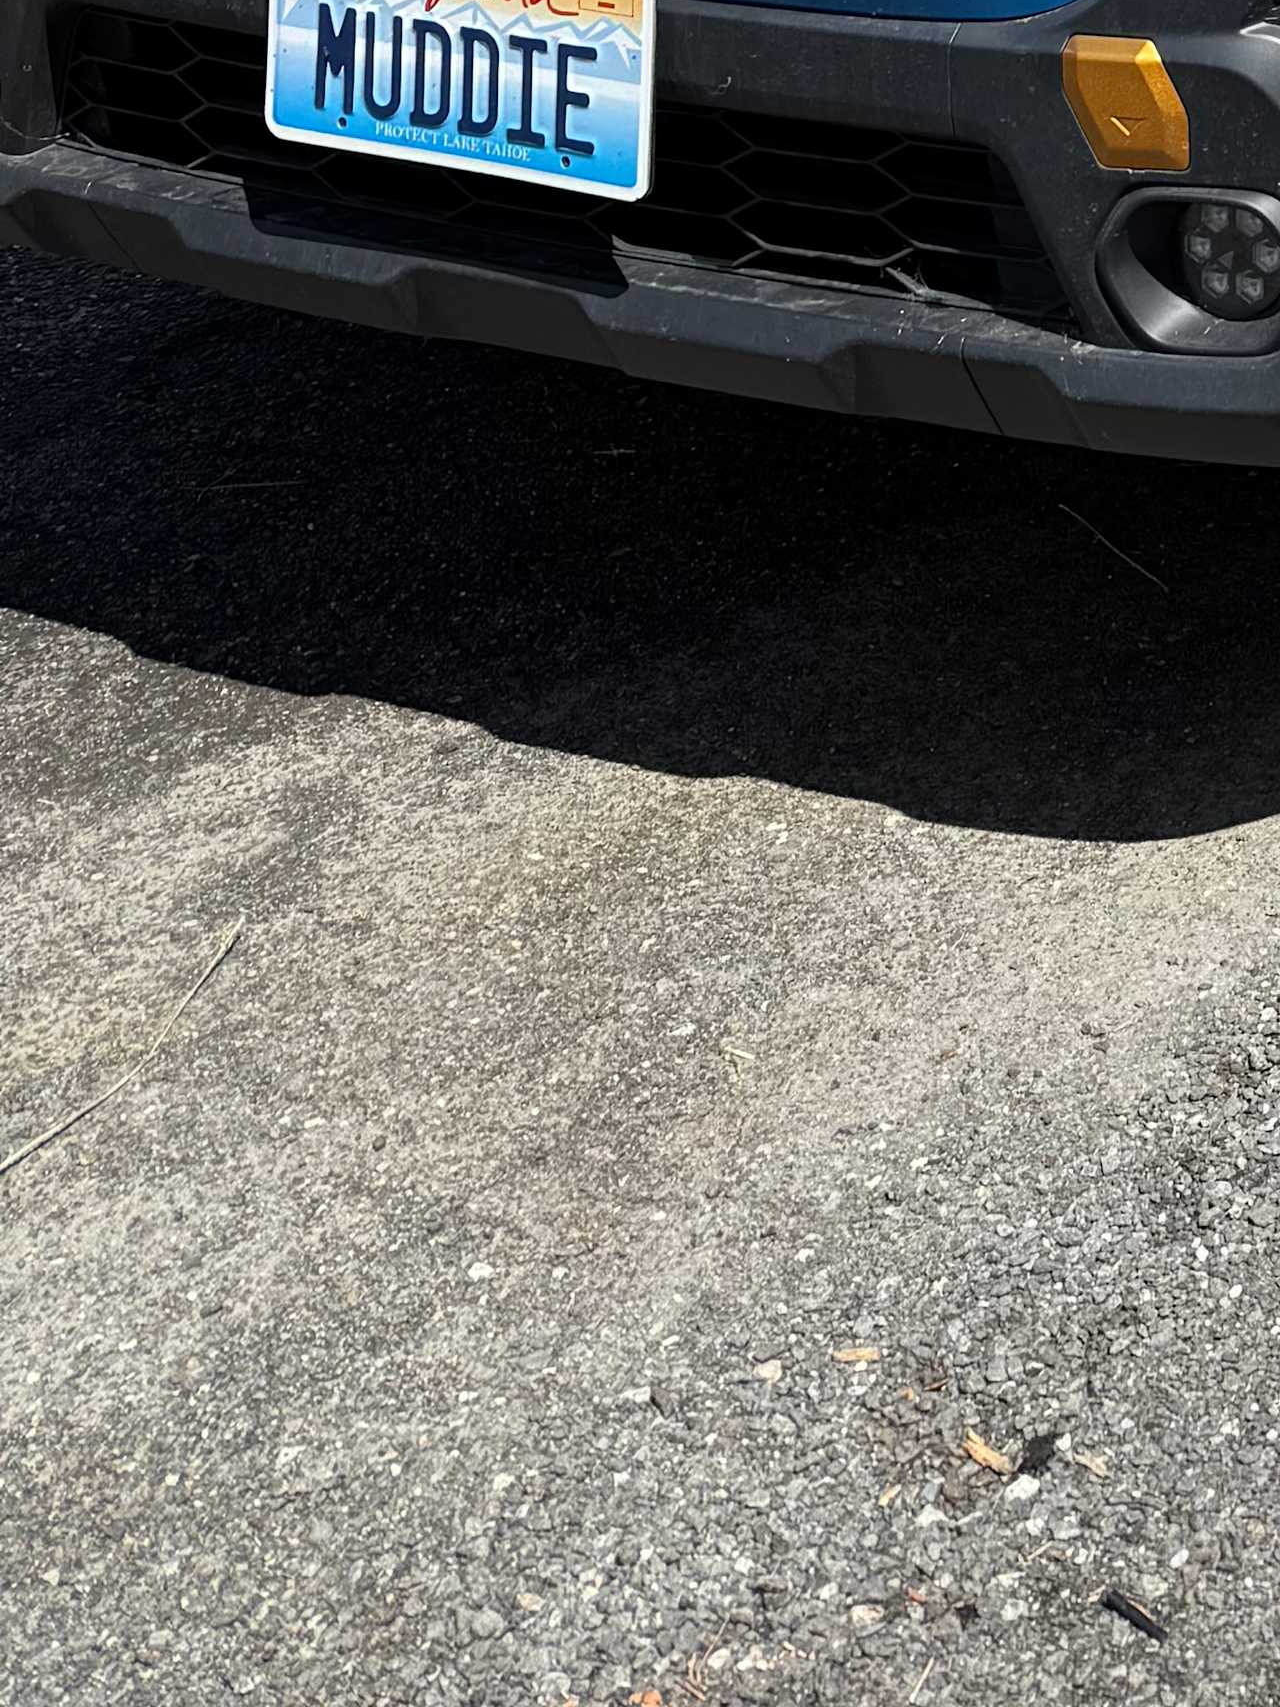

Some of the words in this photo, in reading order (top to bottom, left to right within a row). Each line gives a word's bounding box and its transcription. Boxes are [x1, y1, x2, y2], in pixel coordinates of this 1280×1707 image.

[314, 2, 599, 156] MUDDIE
[374, 120, 440, 146] PROTECT
[443, 133, 480, 153] LAKE
[481, 140, 532, 163] TAHOE
